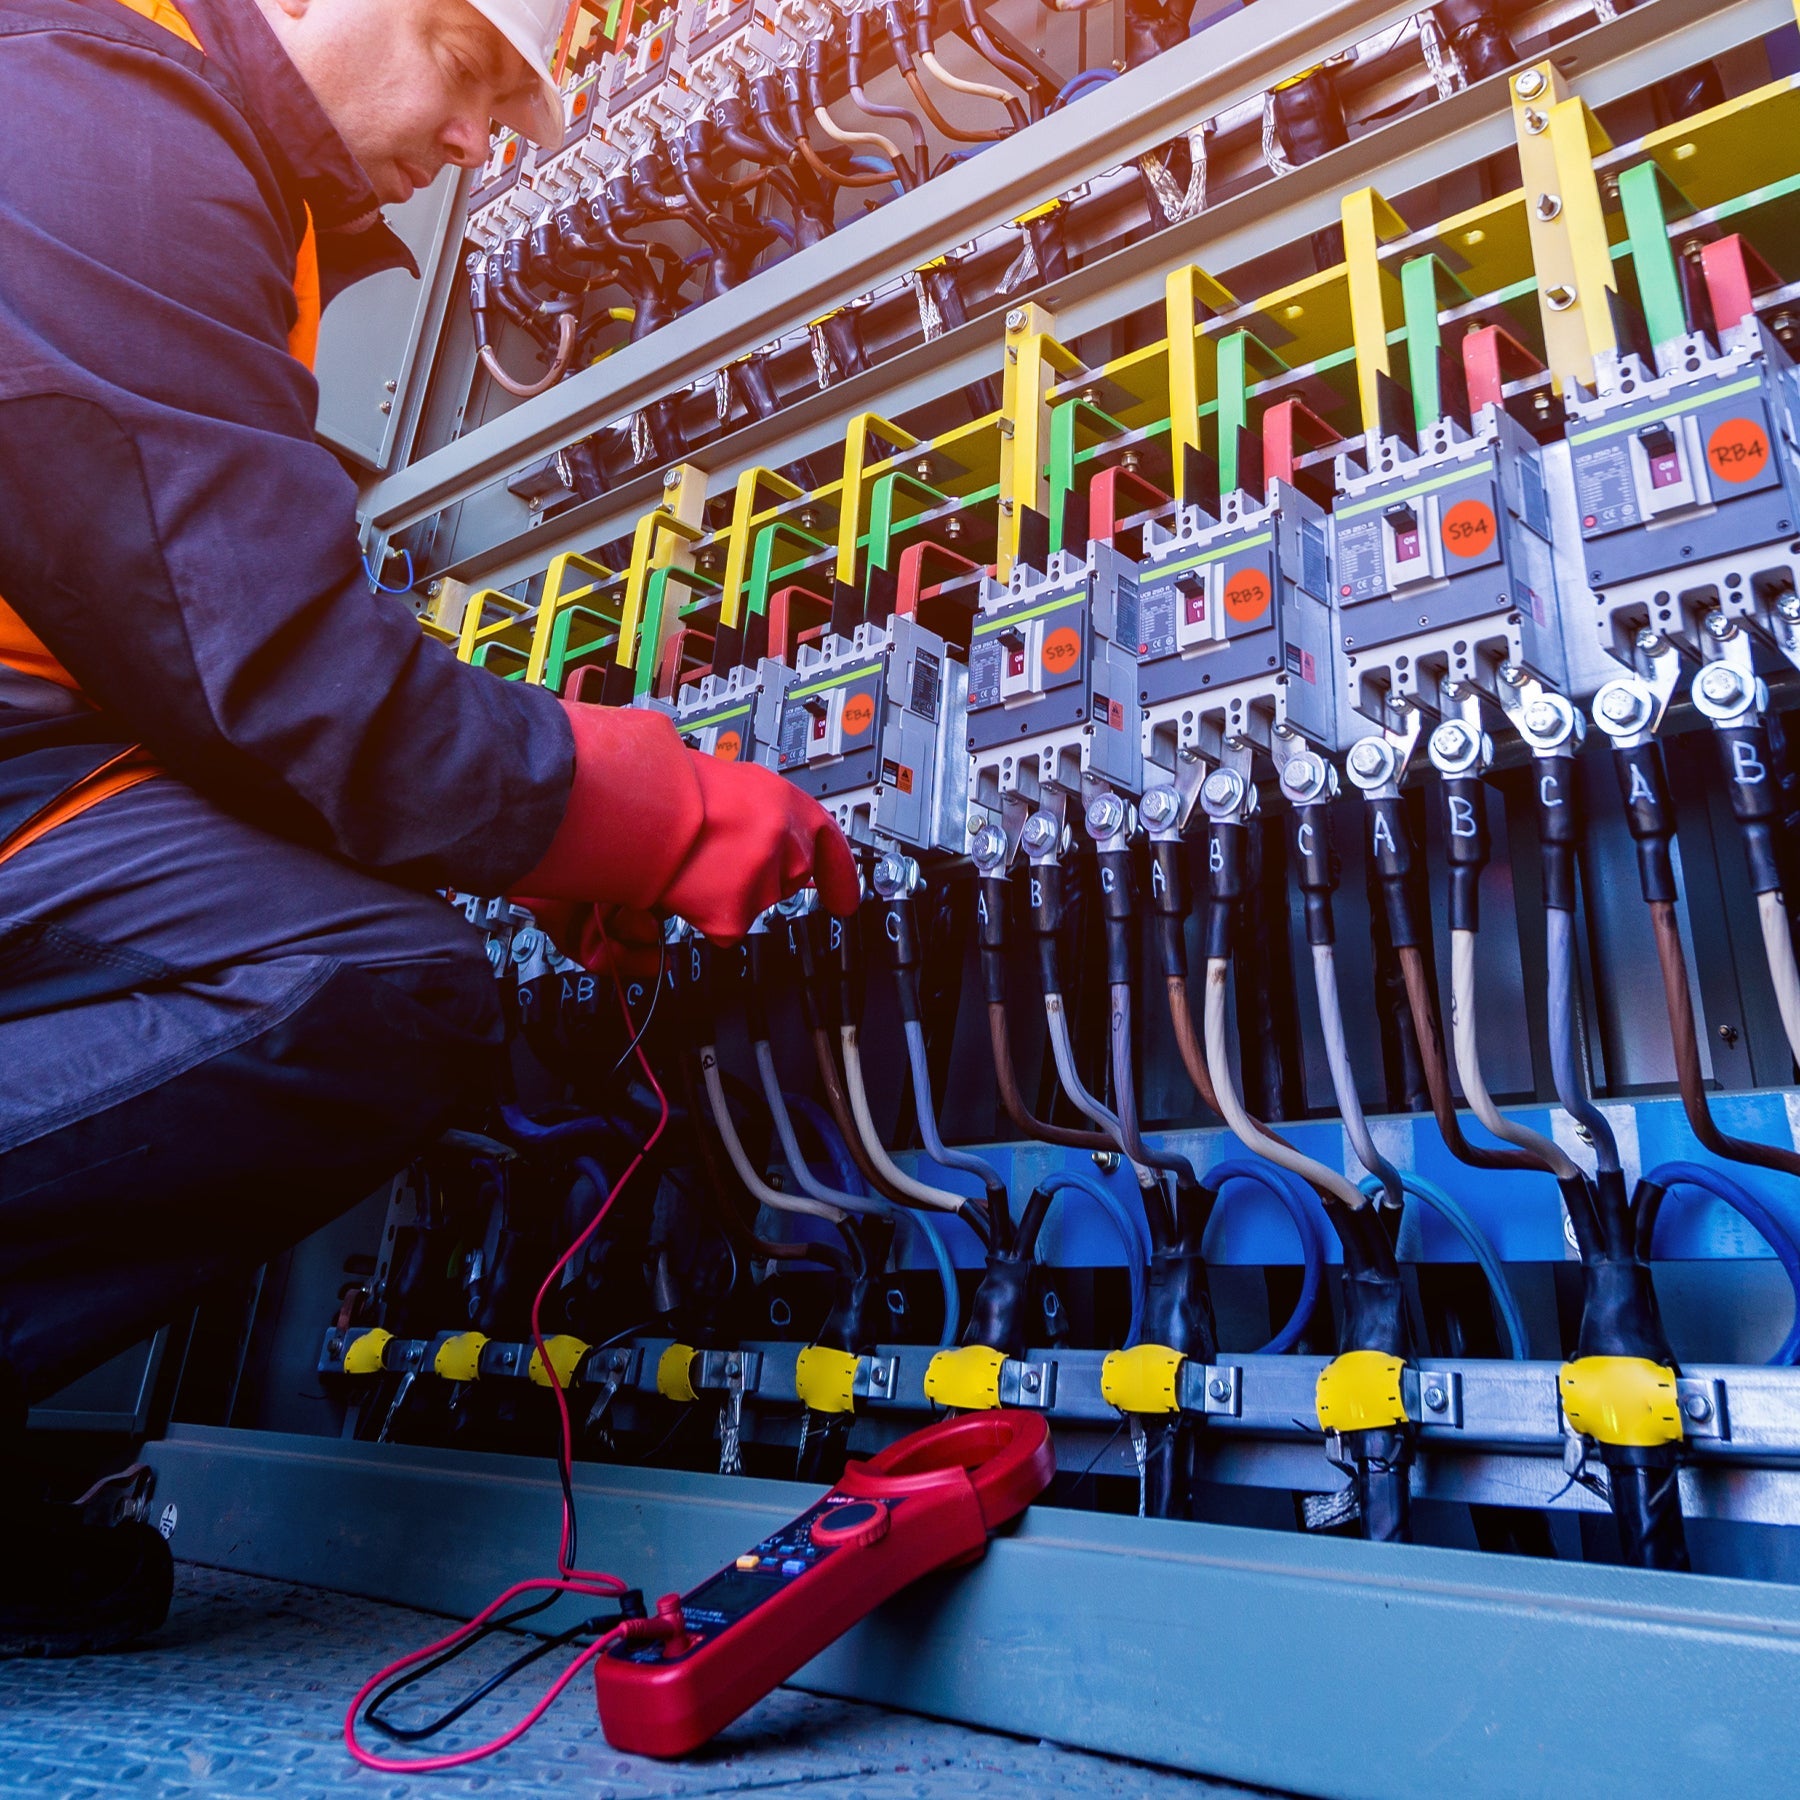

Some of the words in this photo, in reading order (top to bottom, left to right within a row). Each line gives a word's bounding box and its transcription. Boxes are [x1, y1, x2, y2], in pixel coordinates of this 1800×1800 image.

[885, 8, 895, 30] A
[784, 74, 798, 94] A
[716, 107, 726, 128] B
[685, 129, 694, 145] A
[670, 147, 680, 166] C
[632, 167, 640, 184] B
[591, 203, 600, 221] C
[557, 213, 571, 234] B
[530, 233, 539, 248] A
[504, 250, 512, 268] C
[489, 261, 498, 281] B
[470, 278, 480, 299] A
[1712, 440, 1765, 467] RB4
[1659, 460, 1675, 471] ON
[1602, 509, 1616, 520] CE
[1448, 518, 1488, 540] SB4
[1403, 535, 1417, 545] ON
[1356, 579, 1367, 590] CE
[1193, 600, 1203, 609] ON
[1227, 586, 1265, 606] RB3
[1045, 643, 1076, 661] SB3
[1152, 639, 1161, 649] CE
[1014, 654, 1024, 663] ON
[1732, 740, 1767, 784] B
[1540, 775, 1563, 807] C
[1629, 763, 1656, 805] A
[1448, 795, 1477, 837] B
[1298, 823, 1313, 856] C
[1374, 811, 1396, 857] A
[1209, 838, 1224, 872] B
[1152, 859, 1166, 898] A
[1030, 878, 1043, 908] B
[977, 890, 989, 925] A
[830, 916, 842, 951] B
[885, 911, 901, 942] C
[691, 947, 701, 982] B
[577, 976, 595, 1003] B
[627, 983, 643, 1006] C
